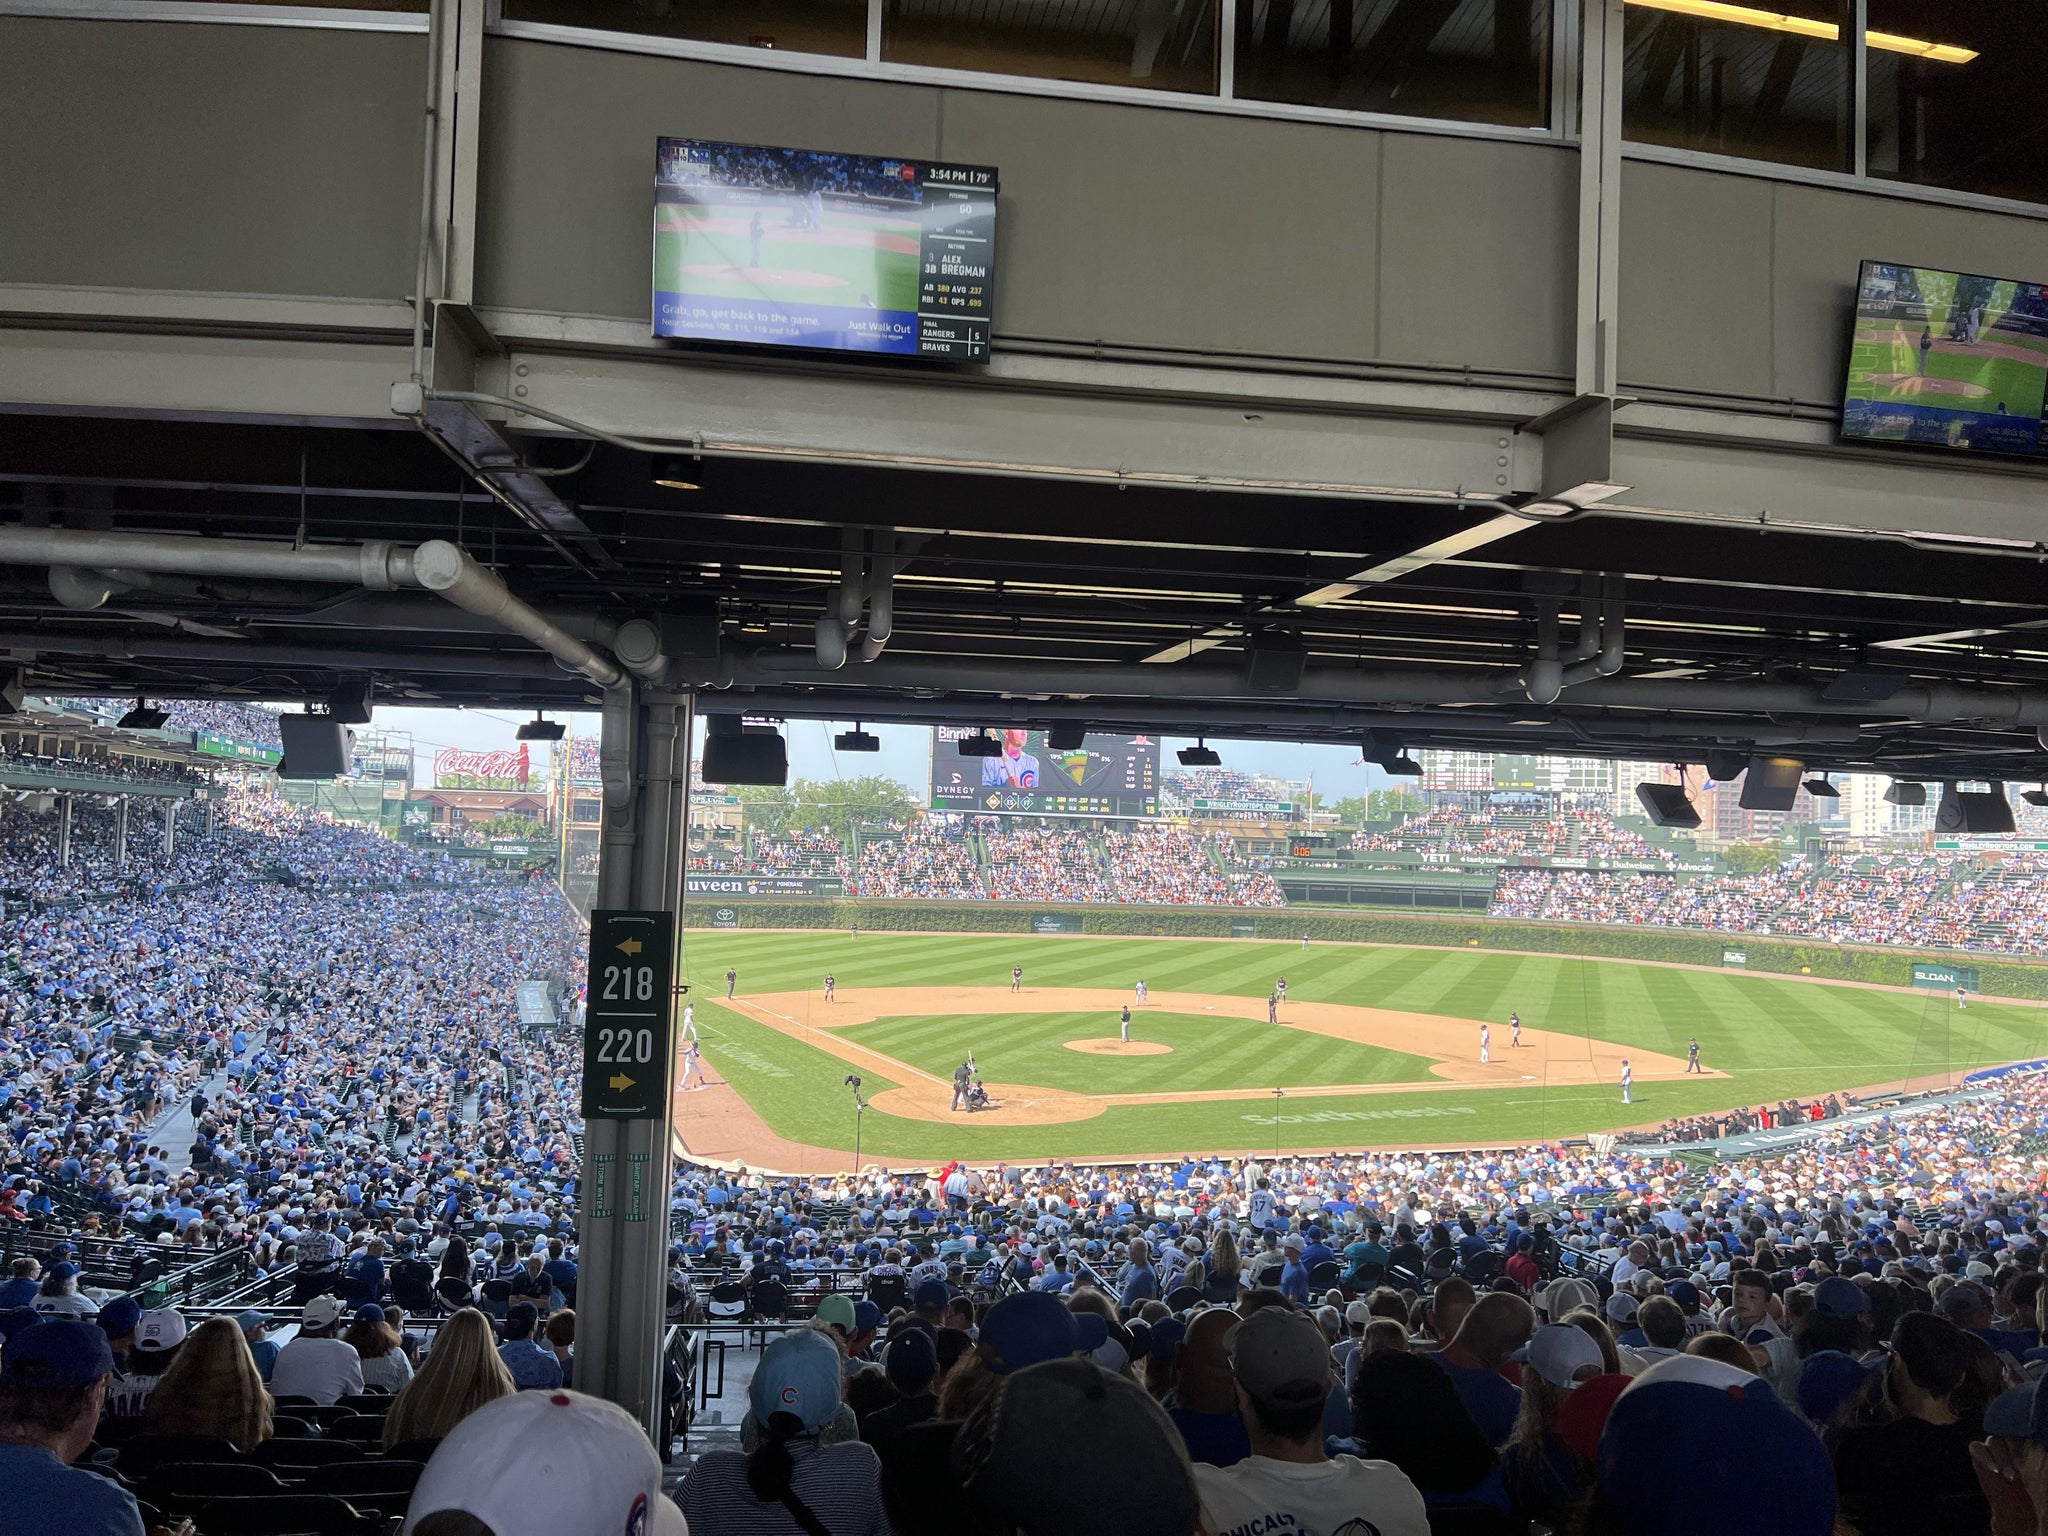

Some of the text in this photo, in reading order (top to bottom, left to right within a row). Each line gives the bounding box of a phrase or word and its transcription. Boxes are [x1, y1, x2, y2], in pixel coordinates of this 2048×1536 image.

[930, 168, 950, 180] 3:54
[952, 171, 966, 182] PM
[942, 254, 962, 264] ALEX
[925, 264, 986, 278] 3B BREGMAN
[924, 283, 934, 291] AB
[952, 285, 966, 294] AVG
[951, 298, 965, 306] OPS
[712, 310, 727, 320] get
[731, 310, 754, 321] back
[758, 312, 768, 322] to
[771, 312, 787, 323] the
[848, 320, 911, 334] Just Walk Out
[923, 329, 955, 339] RANGERS
[922, 343, 950, 352] BRAVES
[434, 748, 523, 779] Coca-Cola
[936, 786, 975, 794] DYNEGY
[1146, 806, 1155, 814] 18
[1420, 853, 1450, 863] YETI
[1466, 856, 1507, 864] tastytrade
[1613, 861, 1656, 870] Budweiser
[1678, 863, 1715, 872] Advocate
[687, 880, 742, 892] uveen
[603, 966, 653, 1001] 218
[597, 1029, 653, 1064] 220
[1240, 1106, 1444, 1125] Southwest
